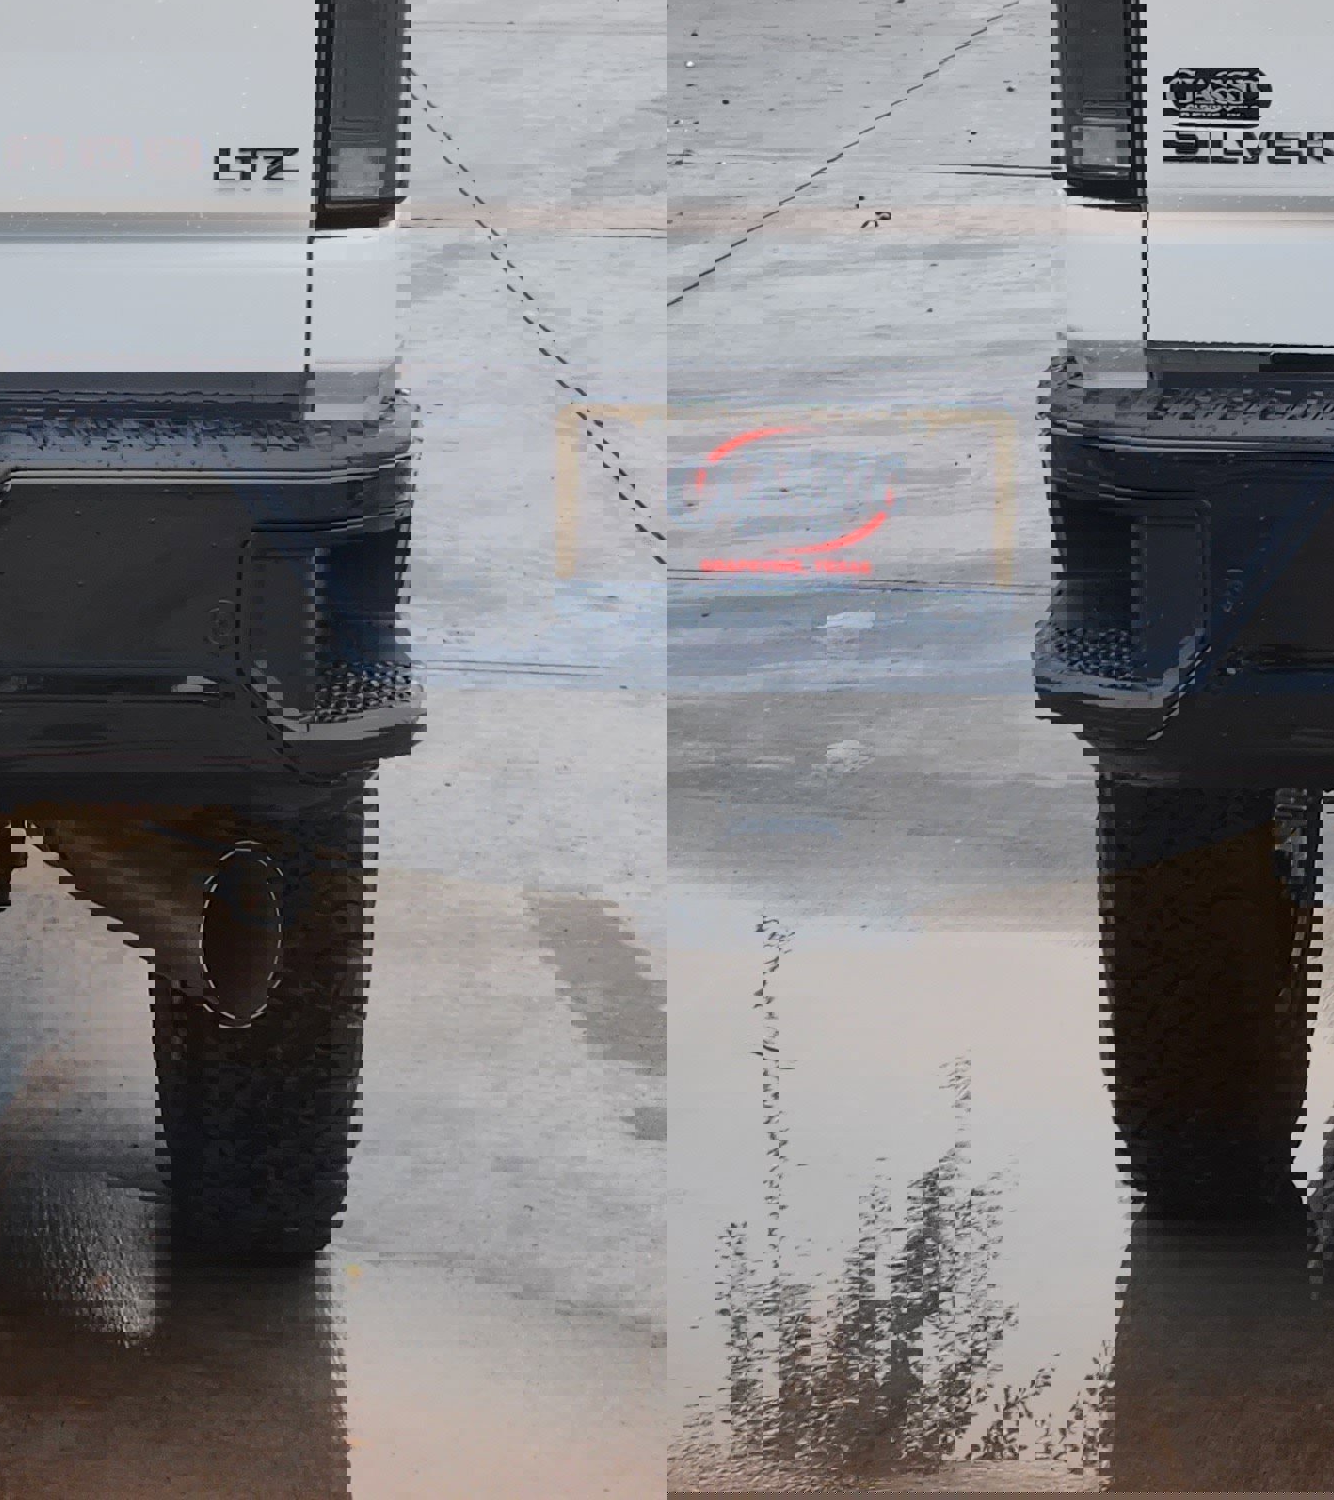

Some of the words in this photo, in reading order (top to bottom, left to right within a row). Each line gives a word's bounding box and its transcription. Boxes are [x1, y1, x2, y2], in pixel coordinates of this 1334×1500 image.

[674, 407, 817, 424] GRAPEVINE,
[825, 409, 902, 425] TEXAS
[665, 457, 907, 529] CLASSIC
[735, 514, 843, 539] Chevrolet
[699, 559, 809, 575] GRAPEVINE,
[813, 560, 872, 574] TEXAS
[663, 600, 761, 621] CLASSIC
[768, 602, 906, 624] CHEVROLET
